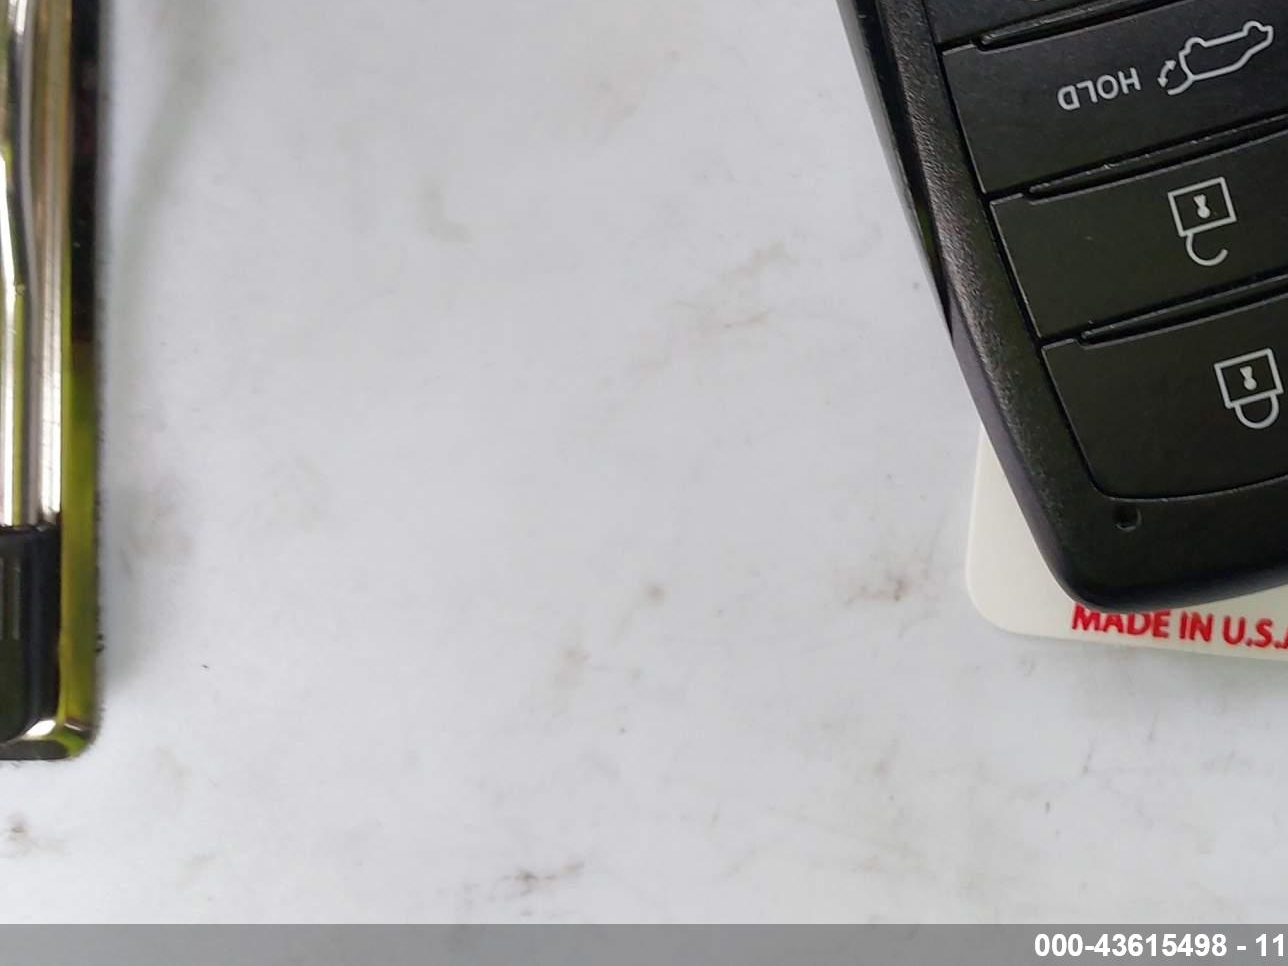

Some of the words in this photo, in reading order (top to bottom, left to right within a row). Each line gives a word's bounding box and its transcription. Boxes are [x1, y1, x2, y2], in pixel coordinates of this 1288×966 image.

[1057, 67, 1142, 111] HOLD
[1071, 602, 1171, 639] MADE
[1178, 611, 1215, 643] IN
